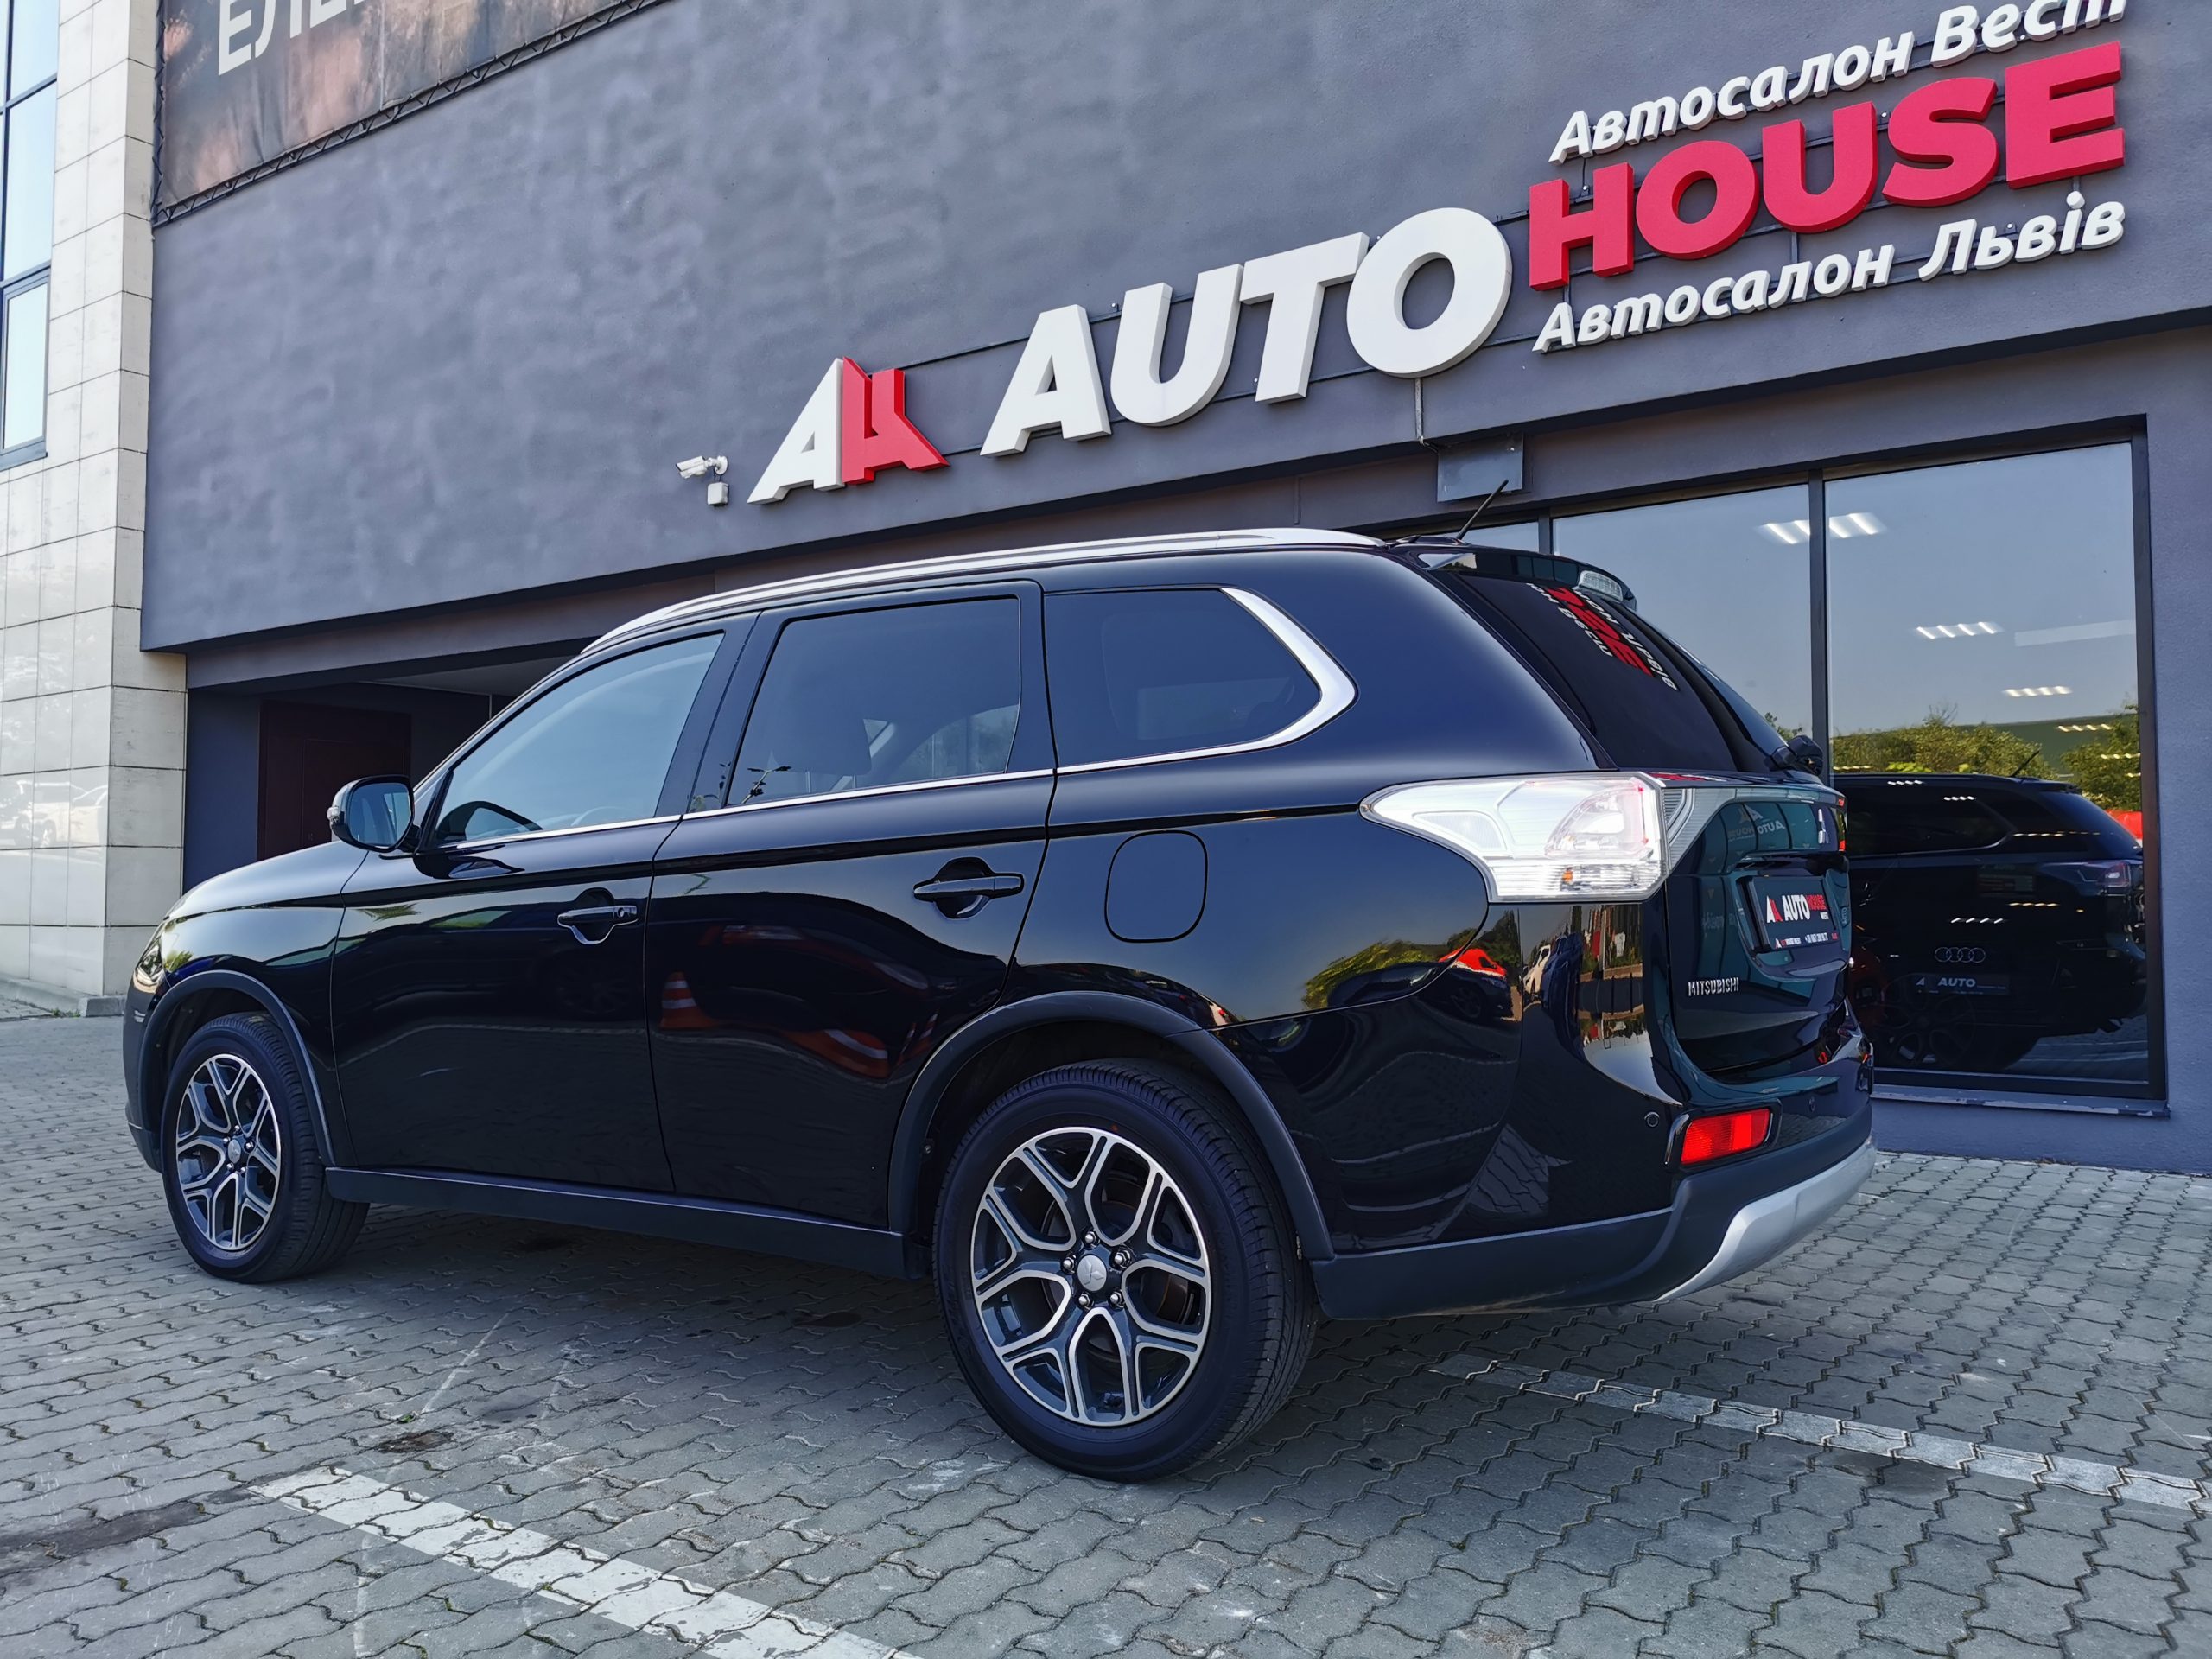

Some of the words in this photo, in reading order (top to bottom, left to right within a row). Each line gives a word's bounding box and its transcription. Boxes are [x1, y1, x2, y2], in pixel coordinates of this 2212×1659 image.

[1548, 30, 1915, 164] Автосалон
[980, 207, 1513, 458] AUTO
[1529, 41, 2126, 291] HOUSE
[1532, 244, 1894, 353] Автосалон
[1917, 191, 2126, 281] Львів
[1781, 893, 1811, 922] AUTO
[1688, 976, 1739, 996] MITSUBISHI
[1937, 977, 1977, 988] AUTO
